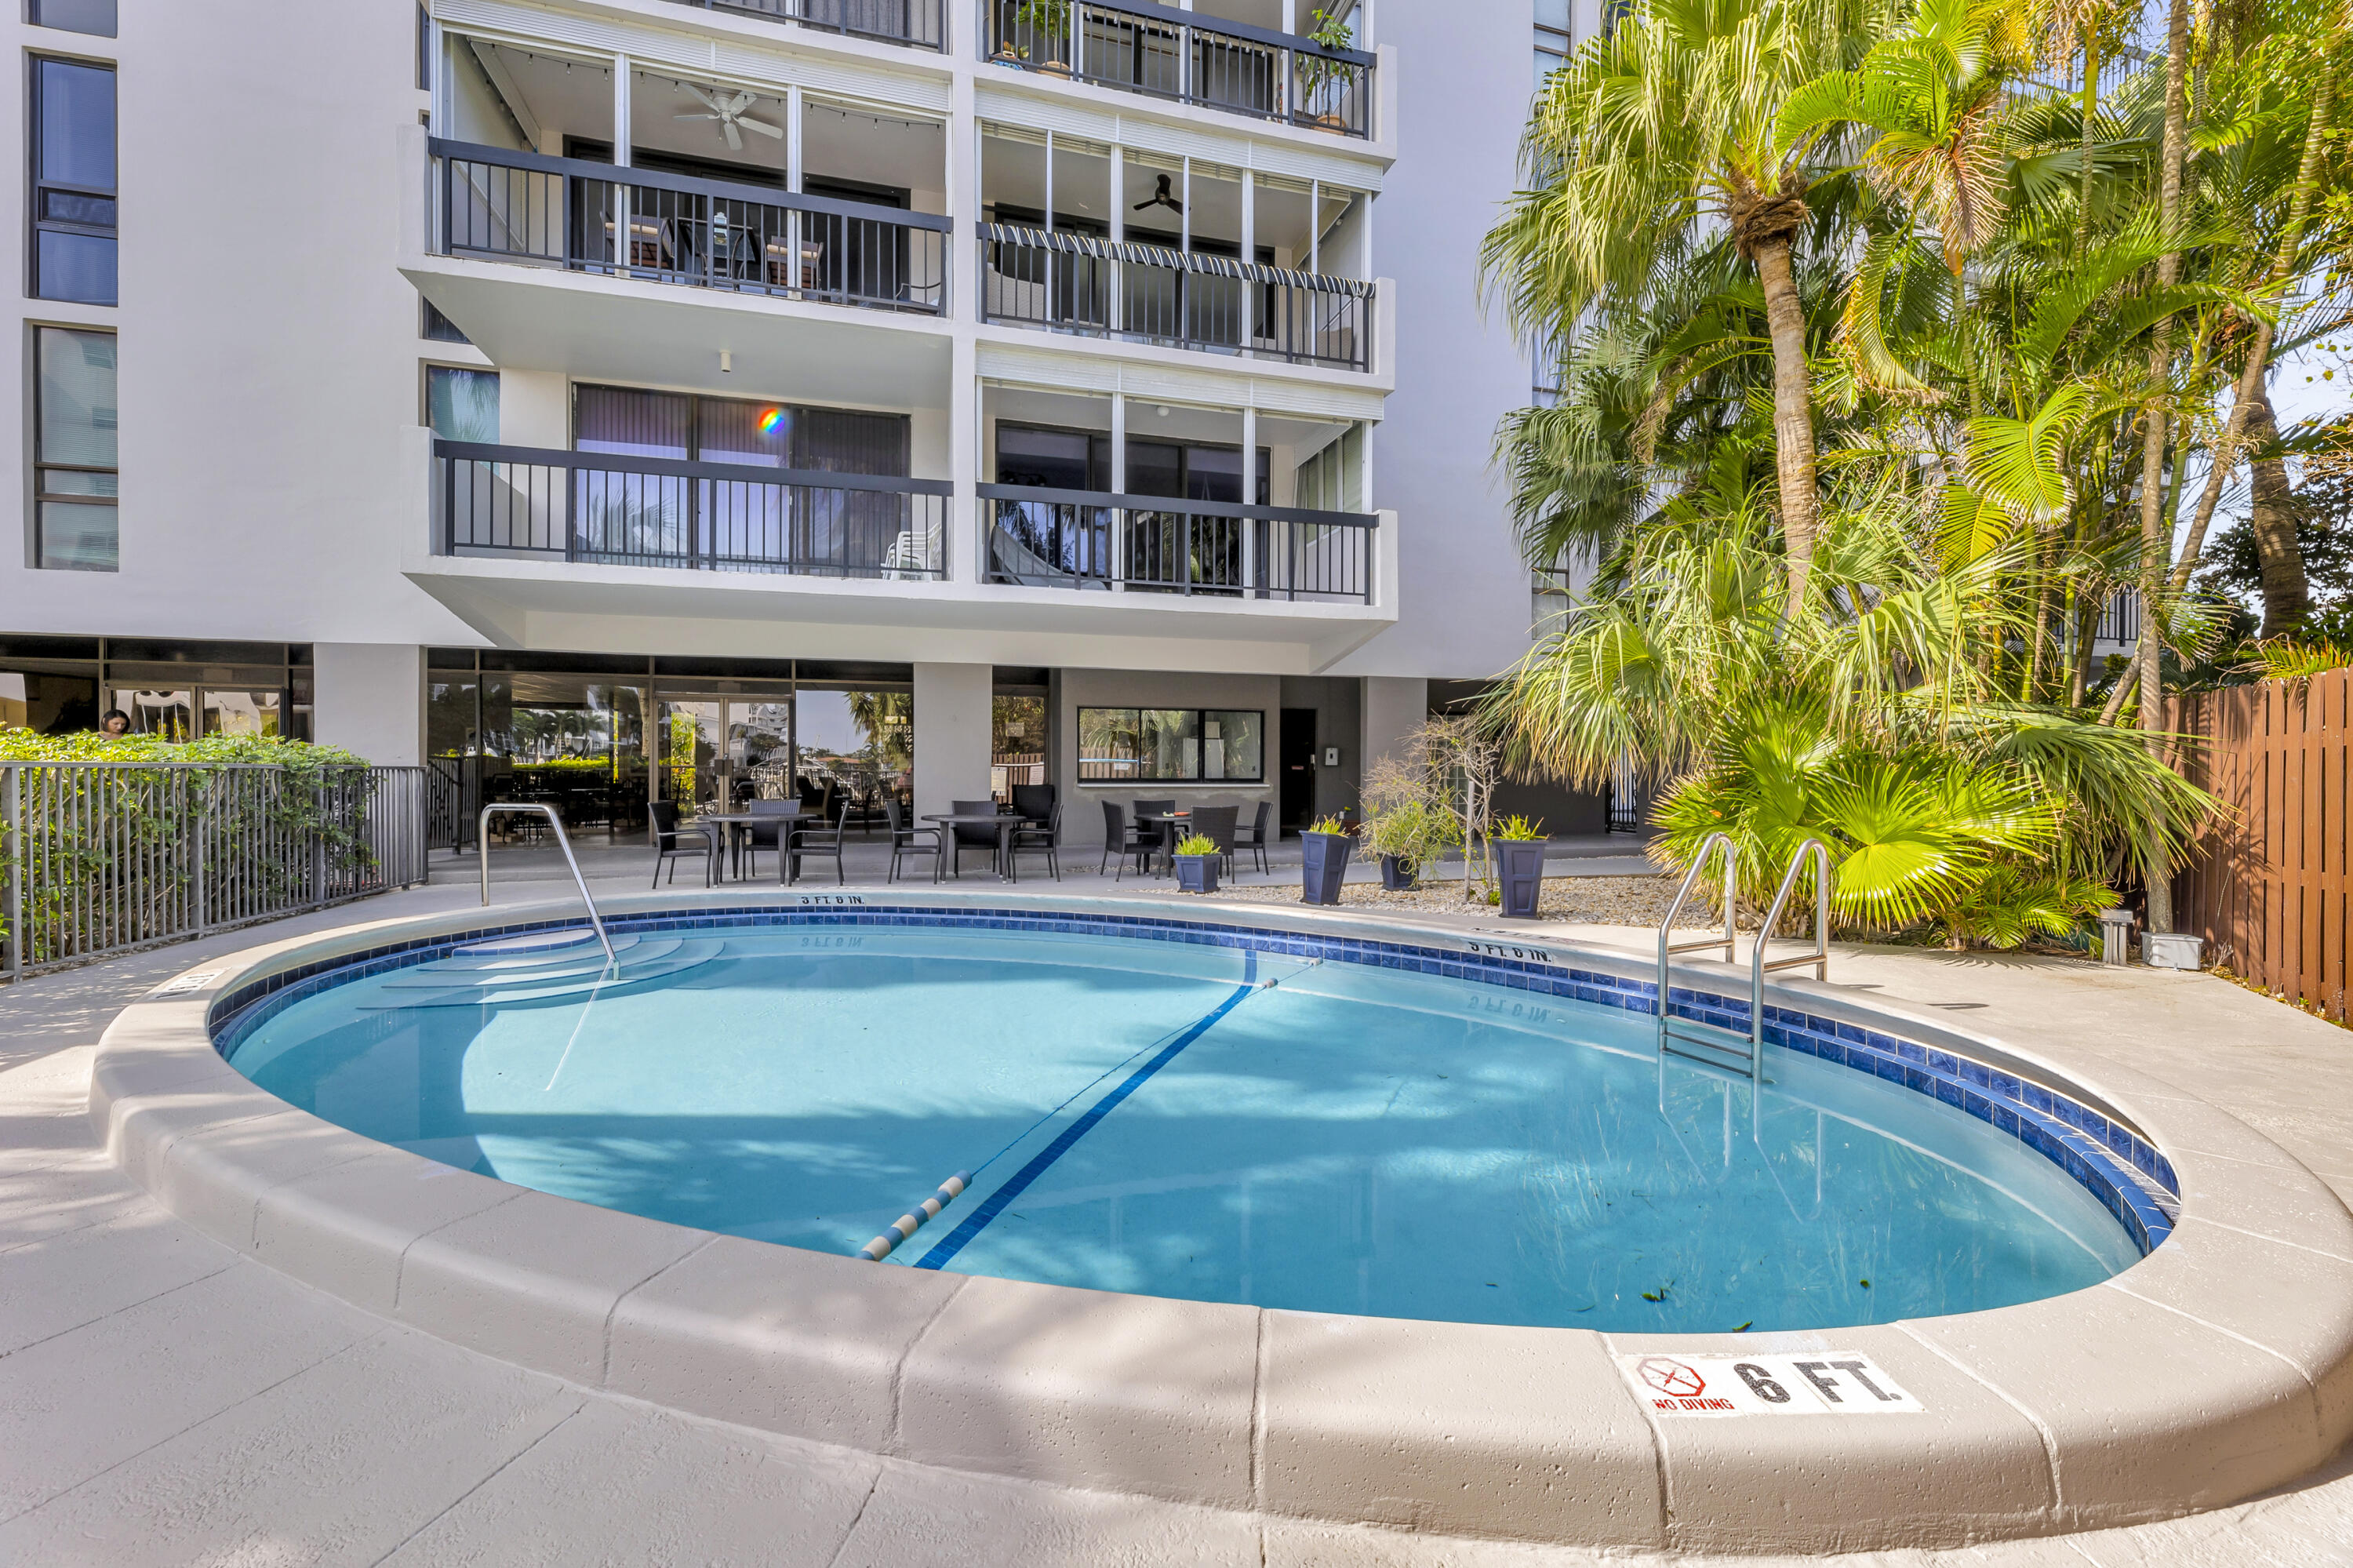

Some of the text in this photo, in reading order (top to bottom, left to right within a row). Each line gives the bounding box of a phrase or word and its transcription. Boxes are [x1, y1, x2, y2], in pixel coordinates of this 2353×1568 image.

[801, 896, 809, 904] 3
[814, 896, 831, 904] FT.
[848, 896, 864, 904] IN.
[1485, 944, 1507, 957] FT.
[1529, 948, 1551, 962] IN.
[1734, 1361, 1902, 1403] 6 FT.
[1652, 1398, 1735, 1410] NO DIVING
